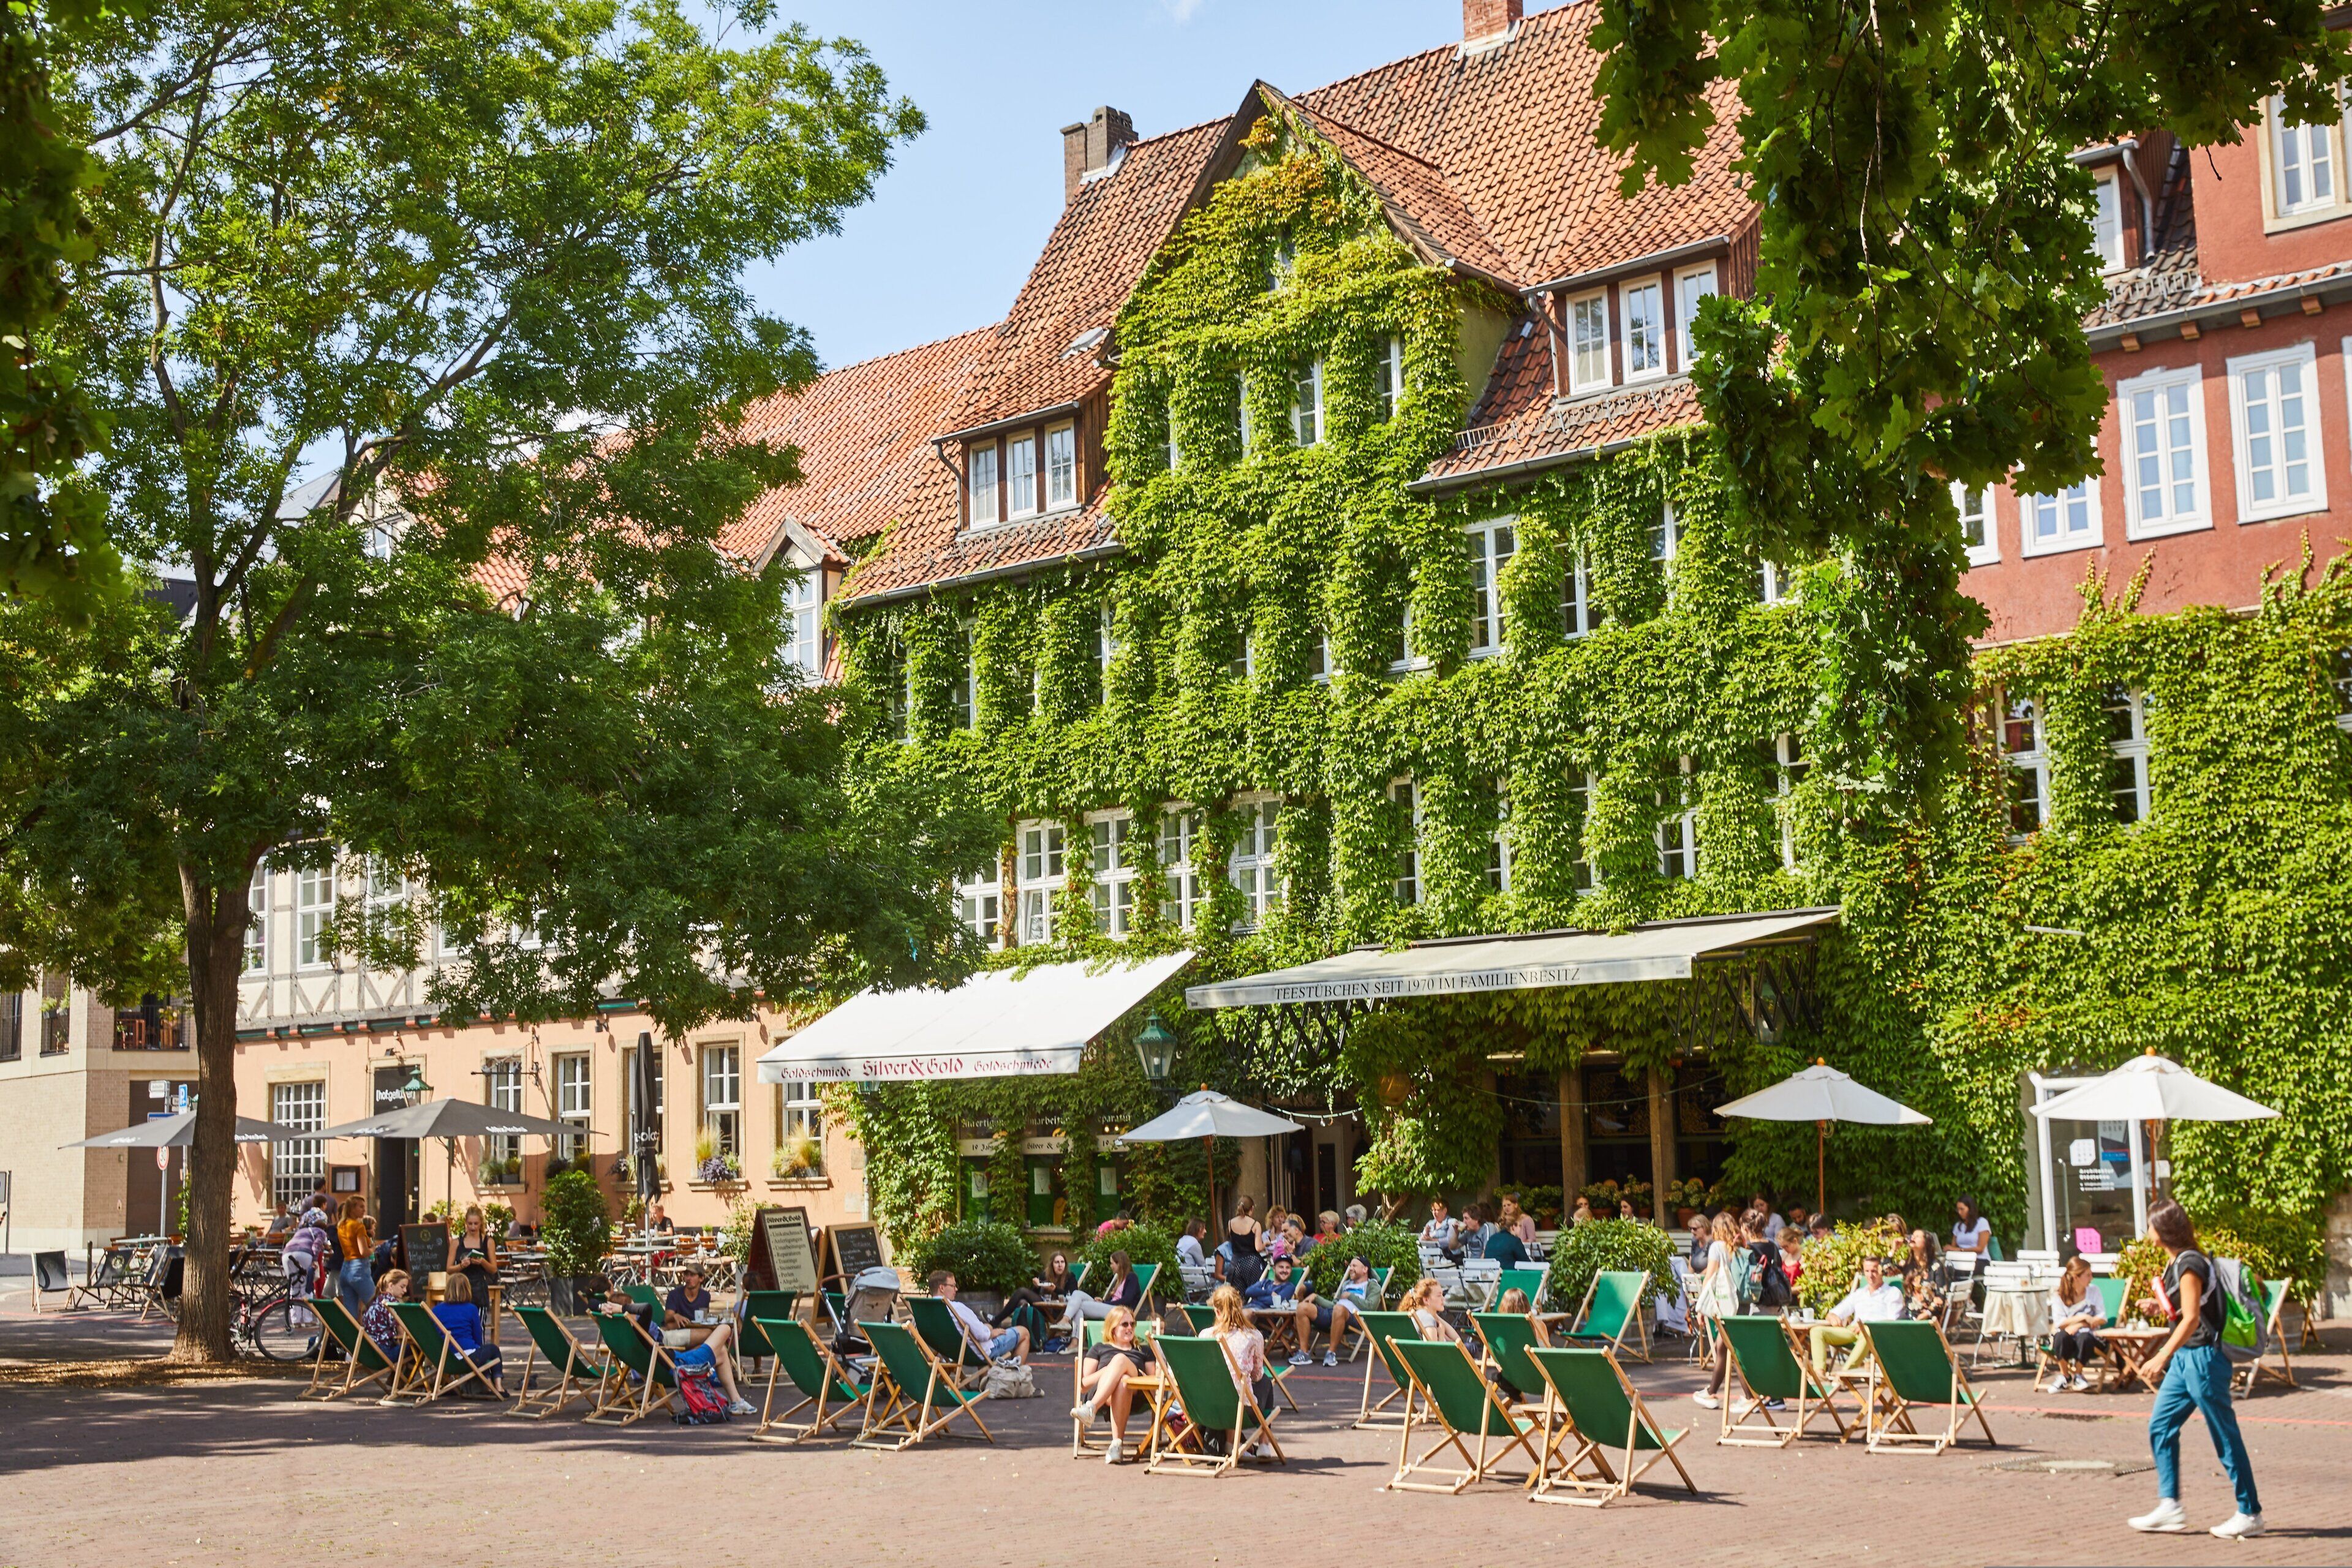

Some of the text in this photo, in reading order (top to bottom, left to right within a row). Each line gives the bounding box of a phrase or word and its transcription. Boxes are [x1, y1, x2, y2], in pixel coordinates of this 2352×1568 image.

[1275, 968, 1580, 1000] TEESTÜBCHEN SEIT 1970 IM FAMILIENBESITZ
[781, 1058, 1052, 1079] Goldschmiede Silver&Gold Goldschmiede
